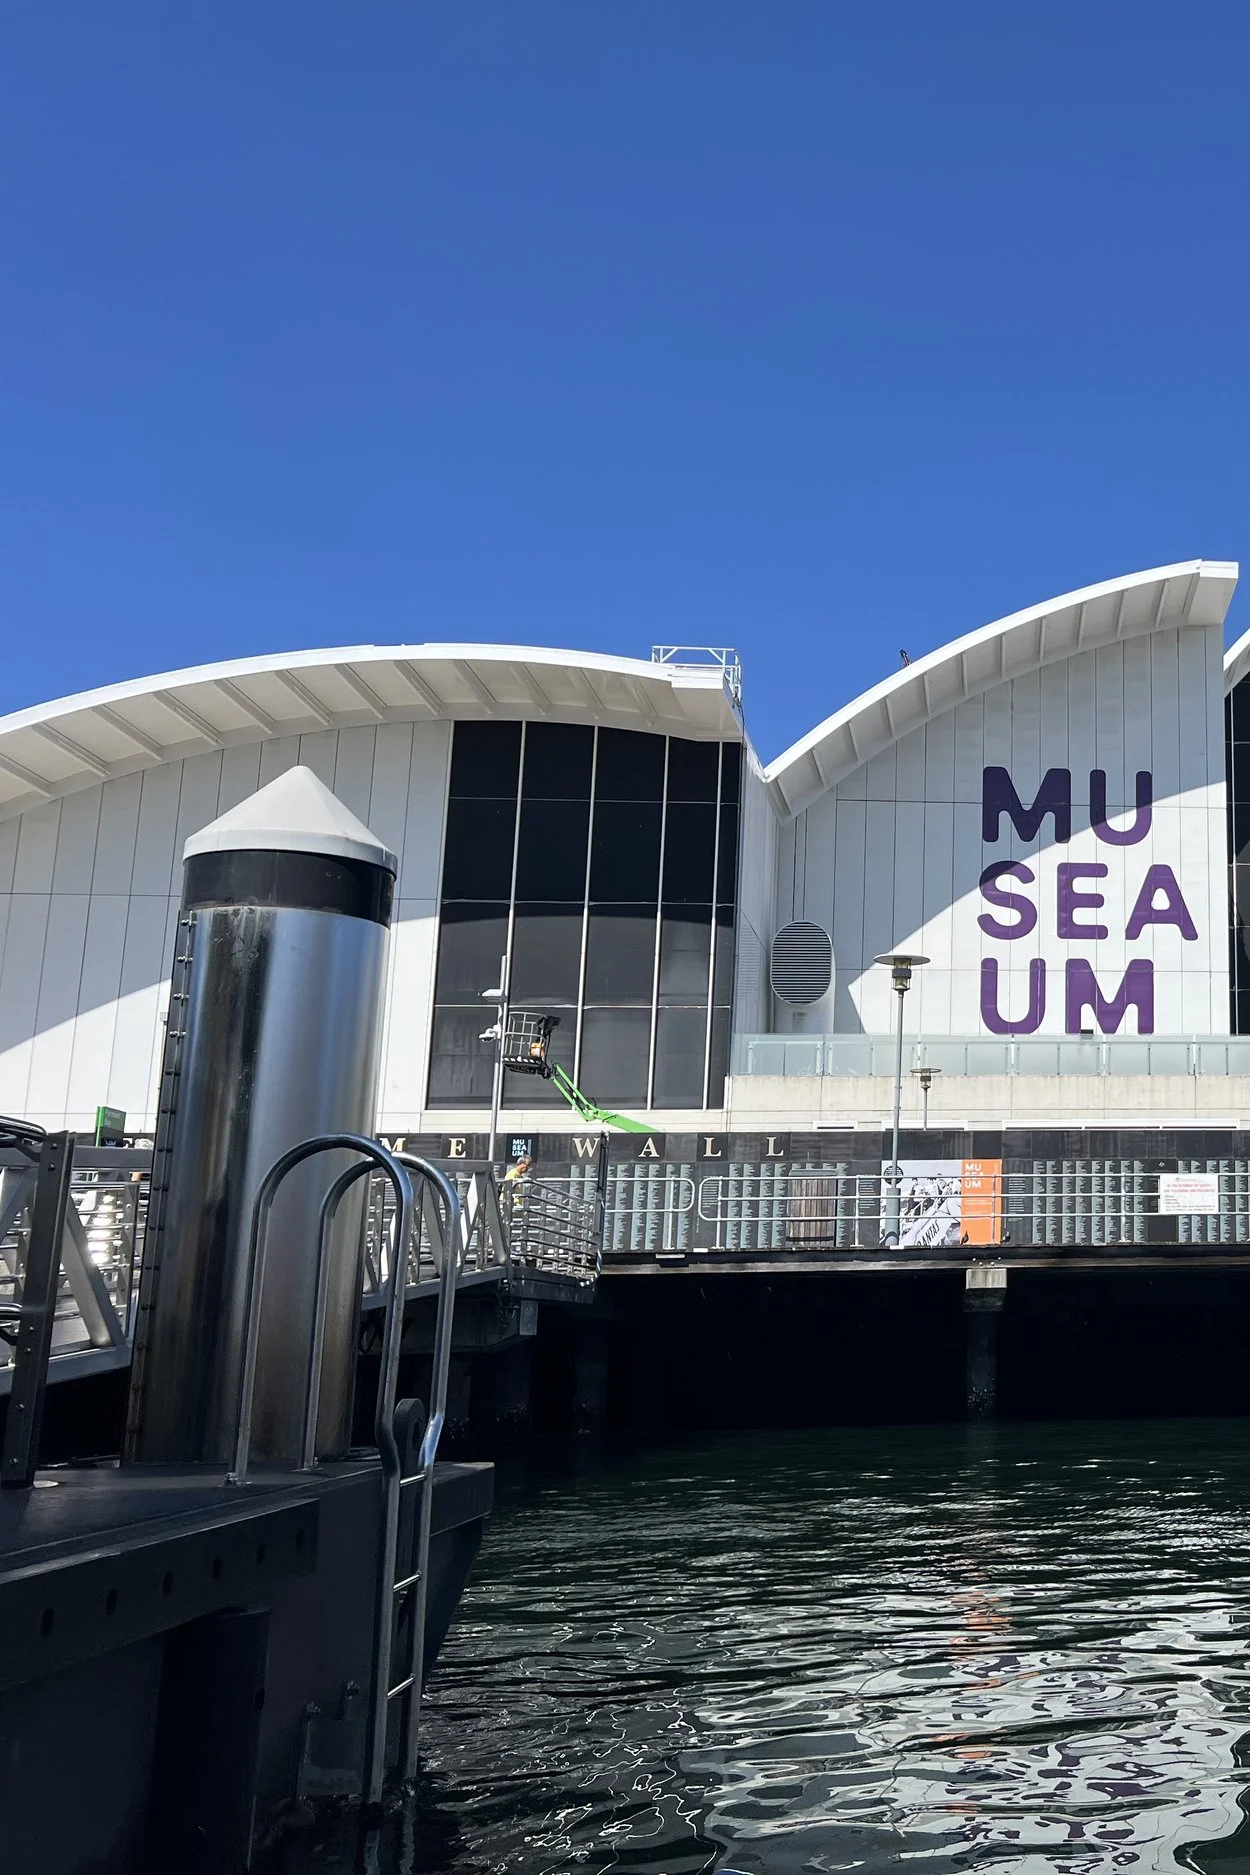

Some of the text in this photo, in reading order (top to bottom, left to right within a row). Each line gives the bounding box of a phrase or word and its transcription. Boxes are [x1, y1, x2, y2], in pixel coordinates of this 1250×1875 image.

[981, 766, 1153, 846] MU
[977, 860, 1198, 941] SEA
[980, 957, 1155, 1035] UM
[572, 1136, 786, 1159] WALL
